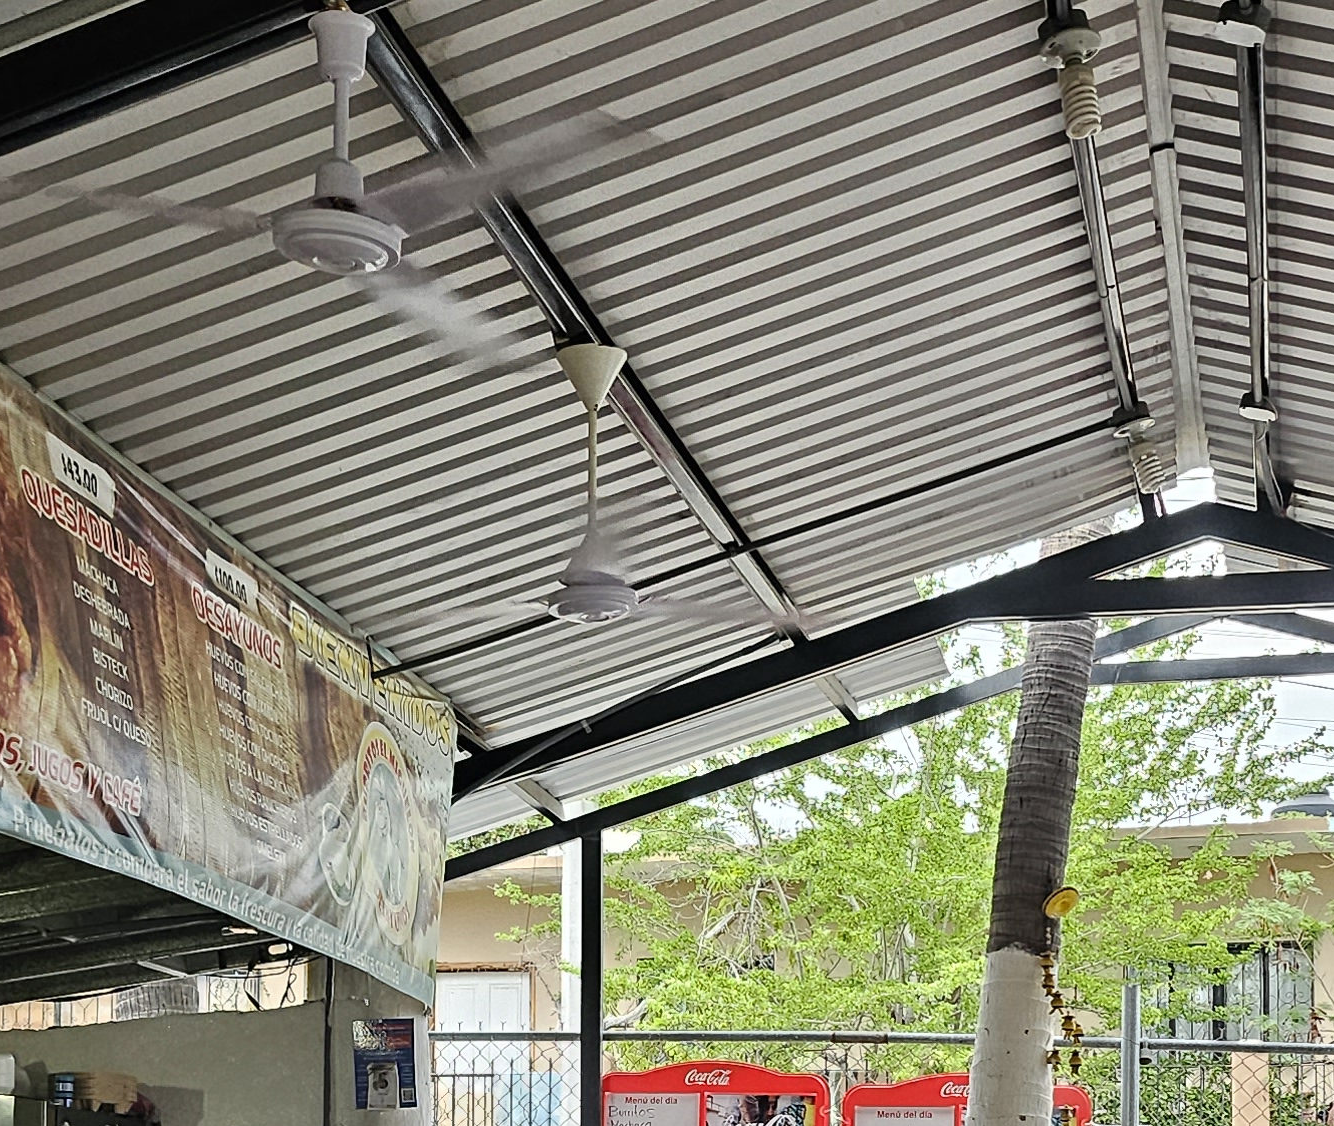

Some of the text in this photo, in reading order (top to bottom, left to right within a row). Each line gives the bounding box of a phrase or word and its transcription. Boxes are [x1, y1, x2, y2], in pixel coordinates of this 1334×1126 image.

[21, 464, 155, 587] QUESADILLAS
[76, 554, 119, 597] MACHACA
[73, 580, 131, 630] DESHEBRADA
[191, 580, 284, 673] DESAYUNOS
[92, 646, 130, 682] BISTECK
[205, 640, 234, 671] HUEVOS
[95, 676, 133, 711] CHORIZO
[214, 671, 242, 701] HUEVOS
[291, 602, 452, 757] BIENVENIDOS
[81, 698, 112, 728] FRIJOL
[122, 719, 152, 747] QUESO
[217, 698, 245, 727] HUEVOS
[28, 741, 85, 794] JUGOS
[86, 762, 103, 800] Y
[103, 774, 143, 817] CAFÉ
[113, 848, 174, 888] compara
[176, 869, 189, 892] el
[192, 877, 227, 907] sabor
[227, 887, 240, 911] la
[240, 892, 287, 932] frescura
[286, 916, 295, 939] y
[684, 1068, 732, 1086] Coca-Cola
[608, 1105, 655, 1119] Burritos
[625, 1096, 648, 1104] Menú
[650, 1096, 663, 1104] del
[877, 1110, 933, 1119] Menú del día
